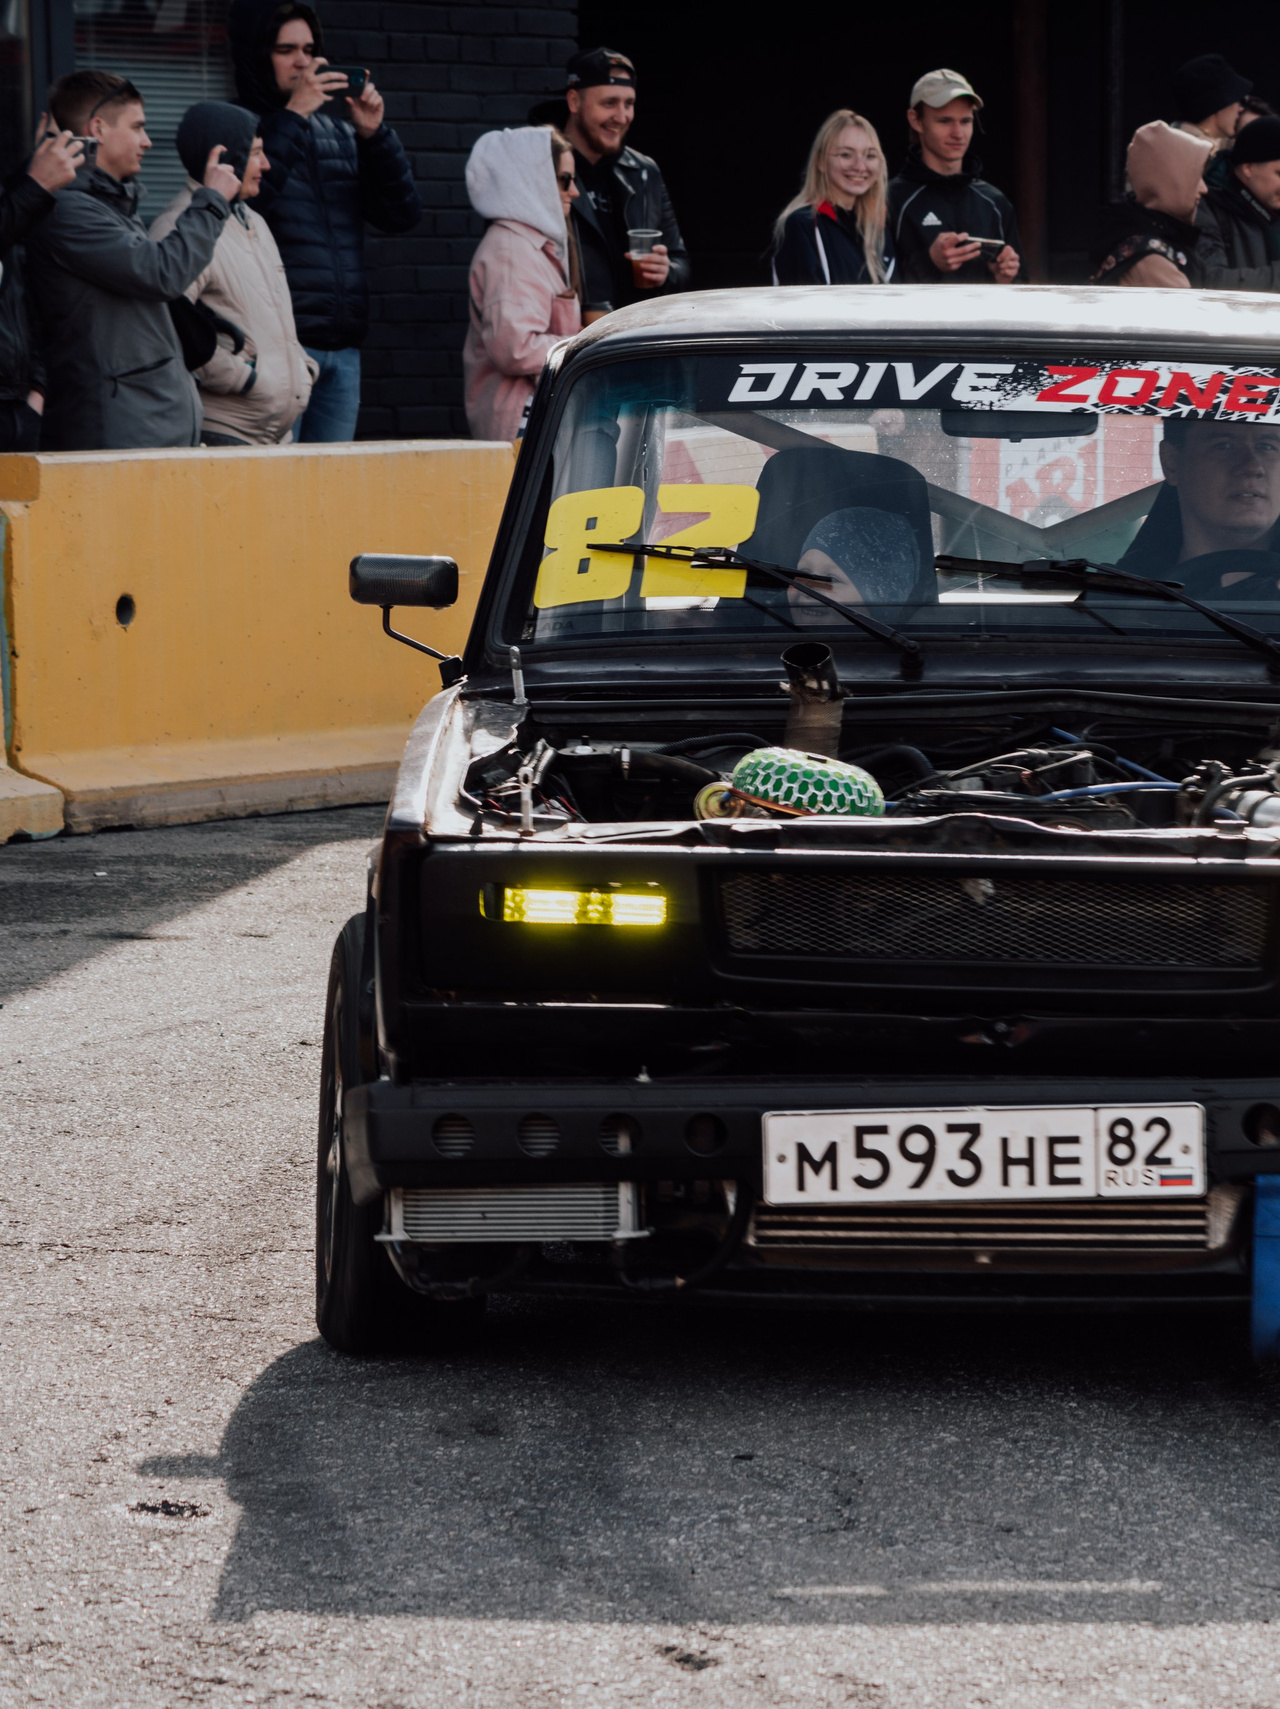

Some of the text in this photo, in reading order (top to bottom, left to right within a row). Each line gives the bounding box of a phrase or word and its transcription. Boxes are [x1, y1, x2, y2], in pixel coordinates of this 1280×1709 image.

[727, 363, 1016, 402] DRIVE
[533, 484, 760, 609] 82
[1107, 1116, 1172, 1167] 82
[1104, 1168, 1155, 1188] RUS
